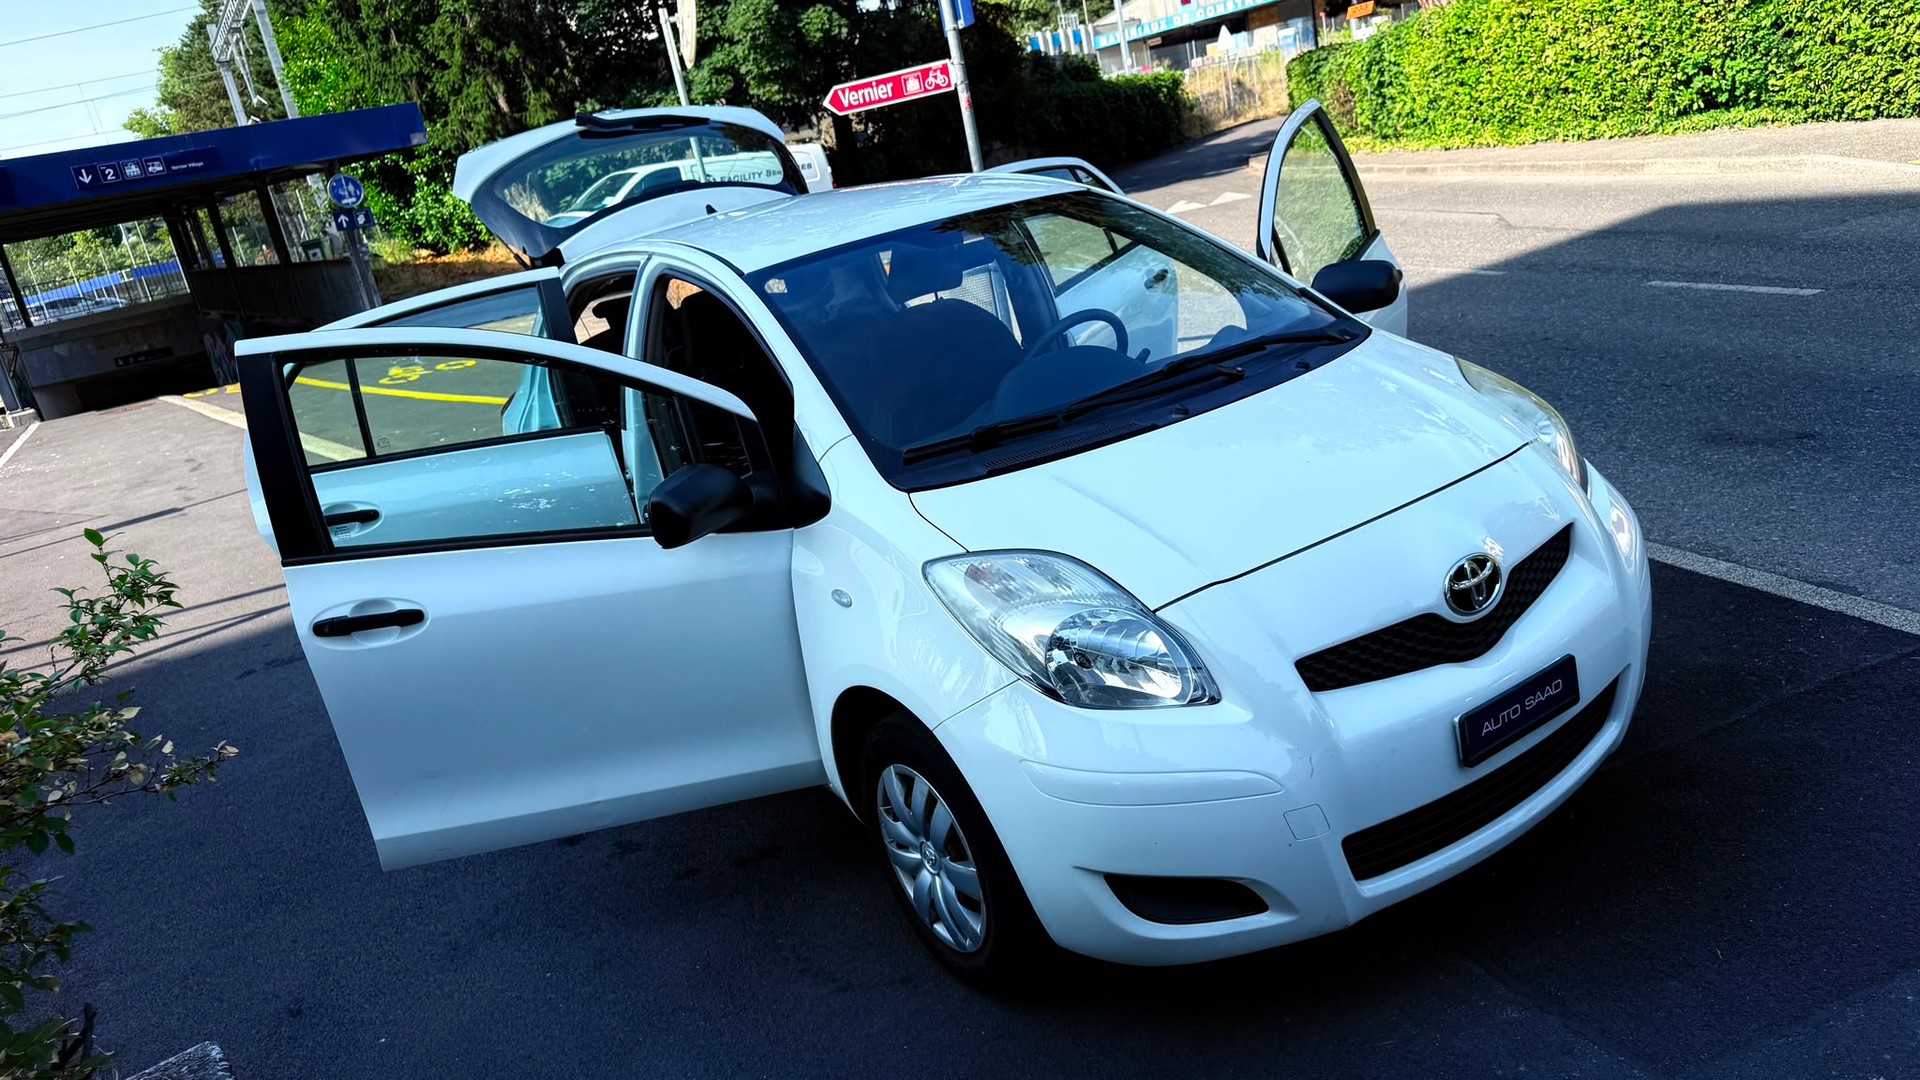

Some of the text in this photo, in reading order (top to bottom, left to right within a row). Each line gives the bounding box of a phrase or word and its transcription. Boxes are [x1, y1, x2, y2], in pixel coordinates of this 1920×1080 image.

[837, 81, 894, 108] Vernier
[105, 168, 116, 180] 2
[720, 171, 763, 182] FACILITY
[1481, 679, 1563, 736] AUTO SAAD
